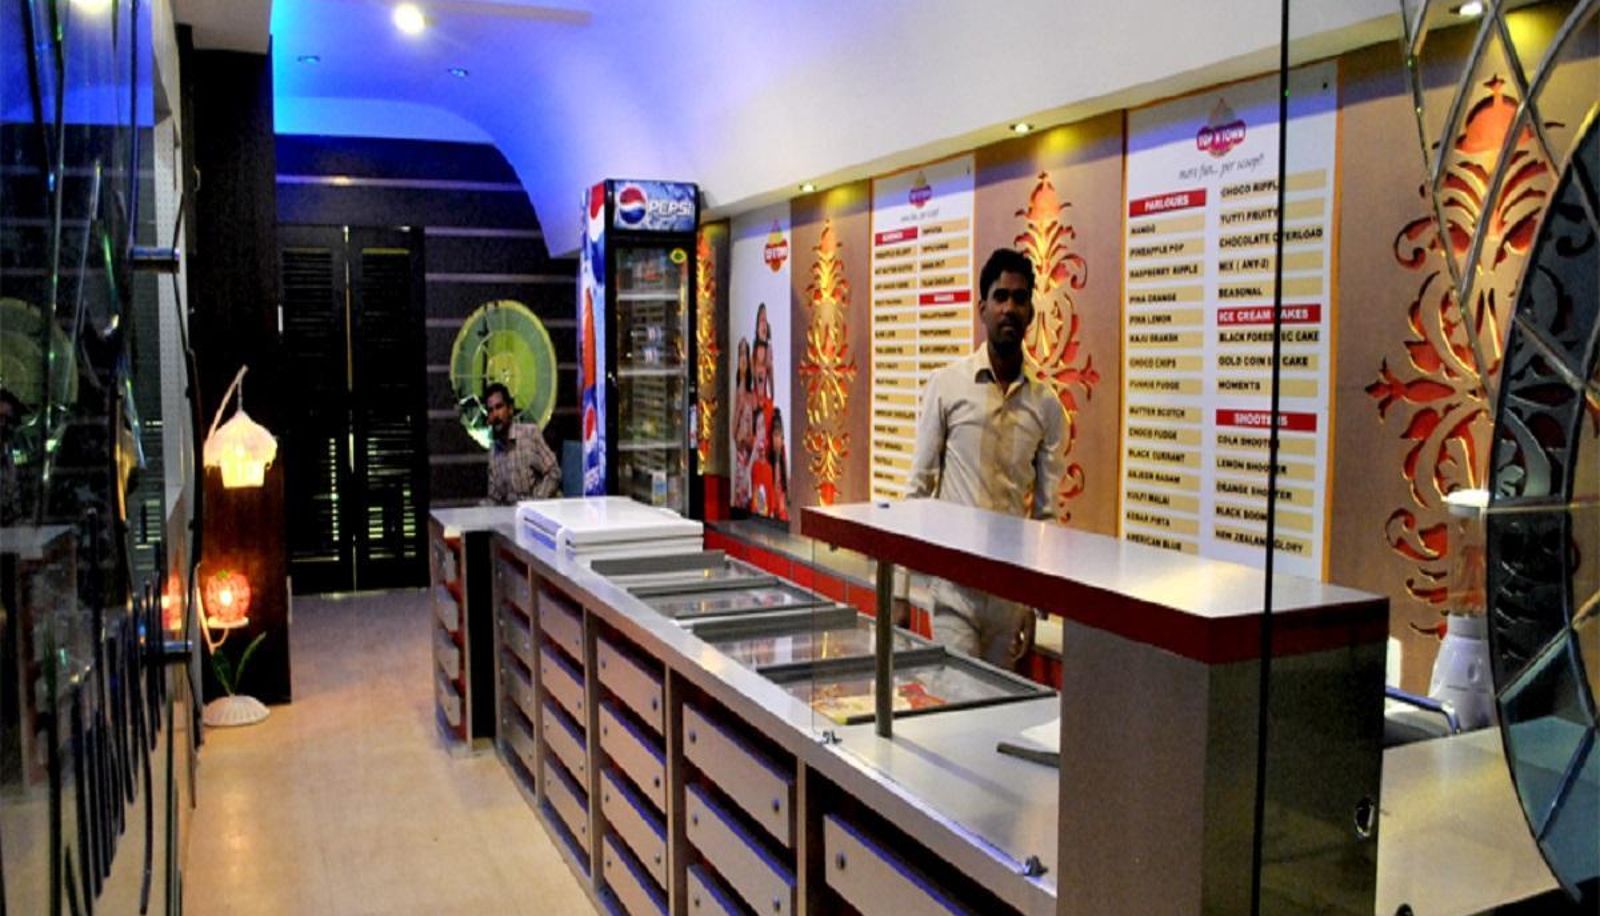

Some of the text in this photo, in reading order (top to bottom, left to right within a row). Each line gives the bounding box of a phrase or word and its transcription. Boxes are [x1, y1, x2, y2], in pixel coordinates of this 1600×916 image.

[1220, 179, 1280, 198] CHOCO RIPPL
[648, 201, 694, 217] PEPSI
[1220, 211, 1245, 224] TUTTI
[1218, 233, 1270, 248] CHOCOLATE
[1130, 243, 1184, 257] PINEAPPLE POP
[1173, 264, 1197, 275] RIPPLE
[1218, 260, 1233, 271] MIX
[1218, 287, 1262, 298] SEASONAL
[1219, 308, 1309, 322] ICE CREAM AKES
[1219, 332, 1245, 342] BLACK
[1247, 332, 1276, 342] FORES
[1295, 330, 1319, 342] CAKE
[1218, 356, 1241, 367] GOLD
[1244, 356, 1265, 367] COIN
[1282, 356, 1308, 367] CAKE
[1218, 381, 1261, 391] MOMENTS
[1129, 406, 1185, 418] BUTTER SCOTCH
[1216, 435, 1279, 449] COLA SHOOT
[1128, 449, 1150, 459] BLACK
[1216, 459, 1287, 475] LEMON SHOOER
[1216, 481, 1292, 500] ORANGE SHOTER
[1216, 506, 1241, 517] BLACK
[1215, 530, 1233, 540] NEW
[1234, 532, 1271, 547] ZEALAN
